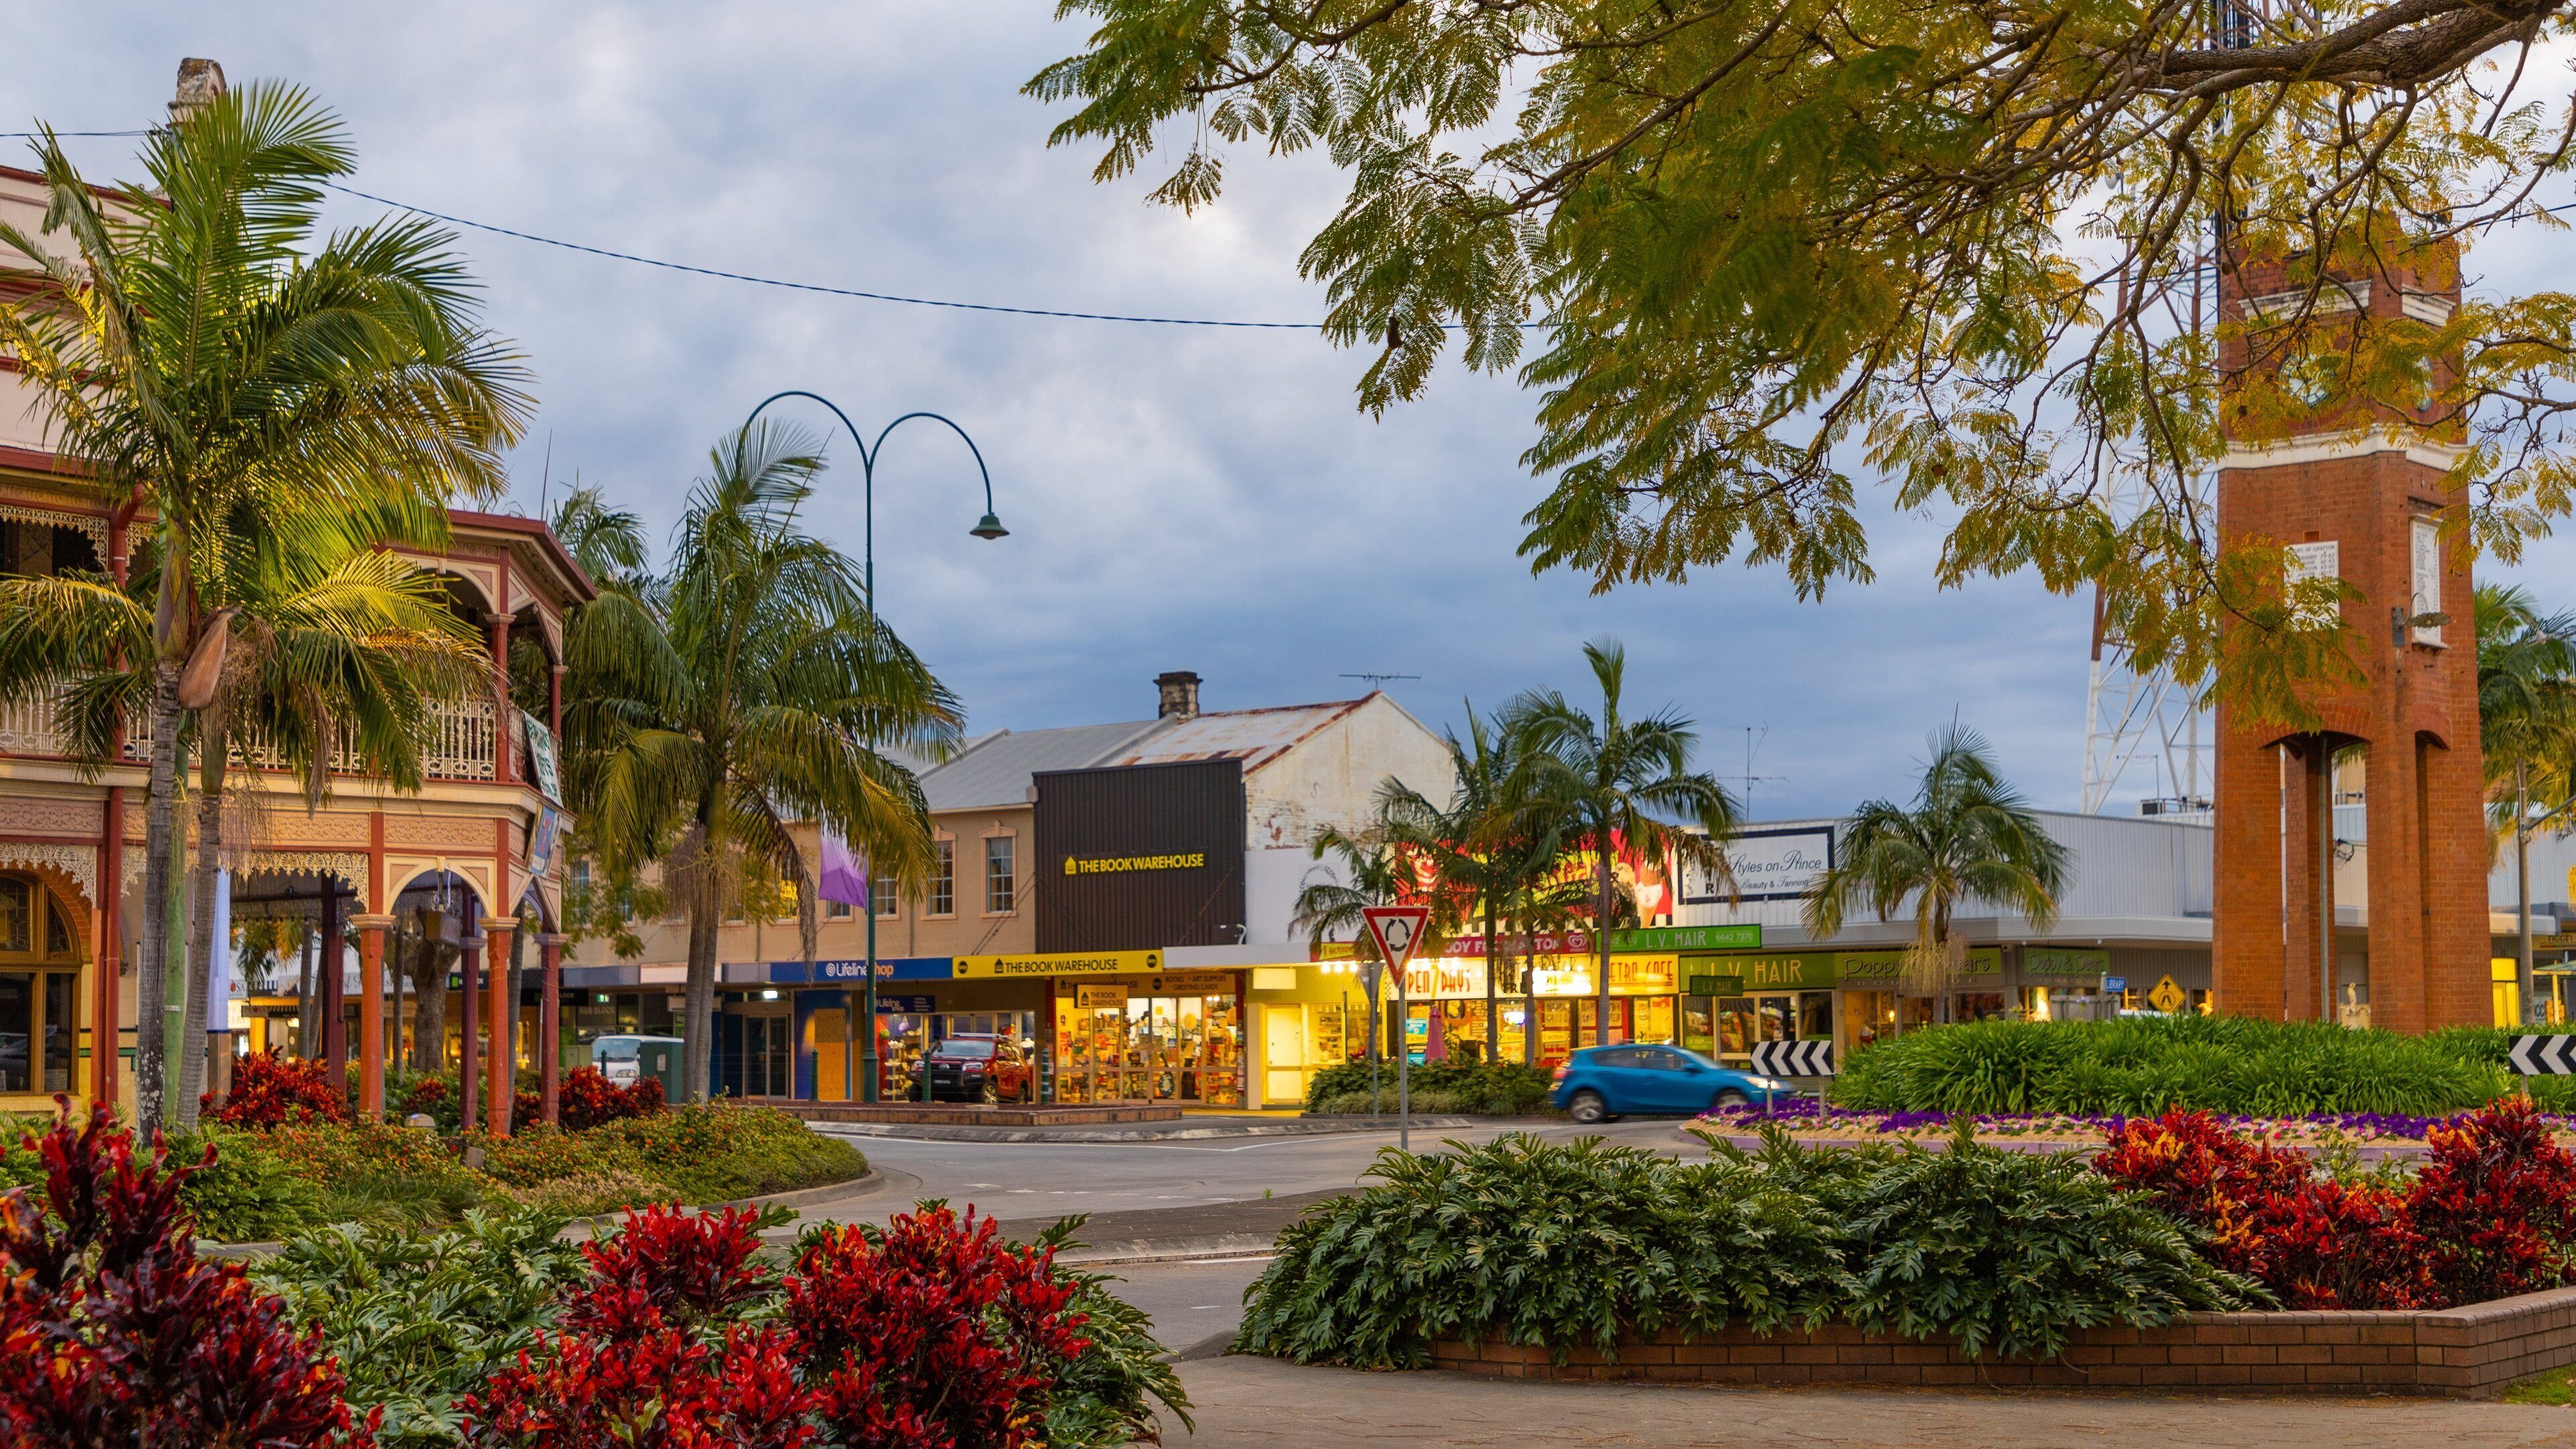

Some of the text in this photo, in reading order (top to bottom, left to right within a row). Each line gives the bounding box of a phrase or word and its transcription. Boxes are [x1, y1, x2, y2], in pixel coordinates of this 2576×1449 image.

[1079, 853, 1205, 873] THE BOOK WAREHOUSE
[1766, 861, 1780, 871] on
[1780, 849, 1821, 871] Prince
[1740, 875, 1810, 890] Beauty & Tanning
[1674, 930, 1707, 947] HAIR
[875, 961, 894, 977] hop
[1006, 959, 1118, 973] THE BOOK WAREHOUSE
[1754, 959, 1803, 984] HAIR
[1407, 970, 1430, 994] PEN
